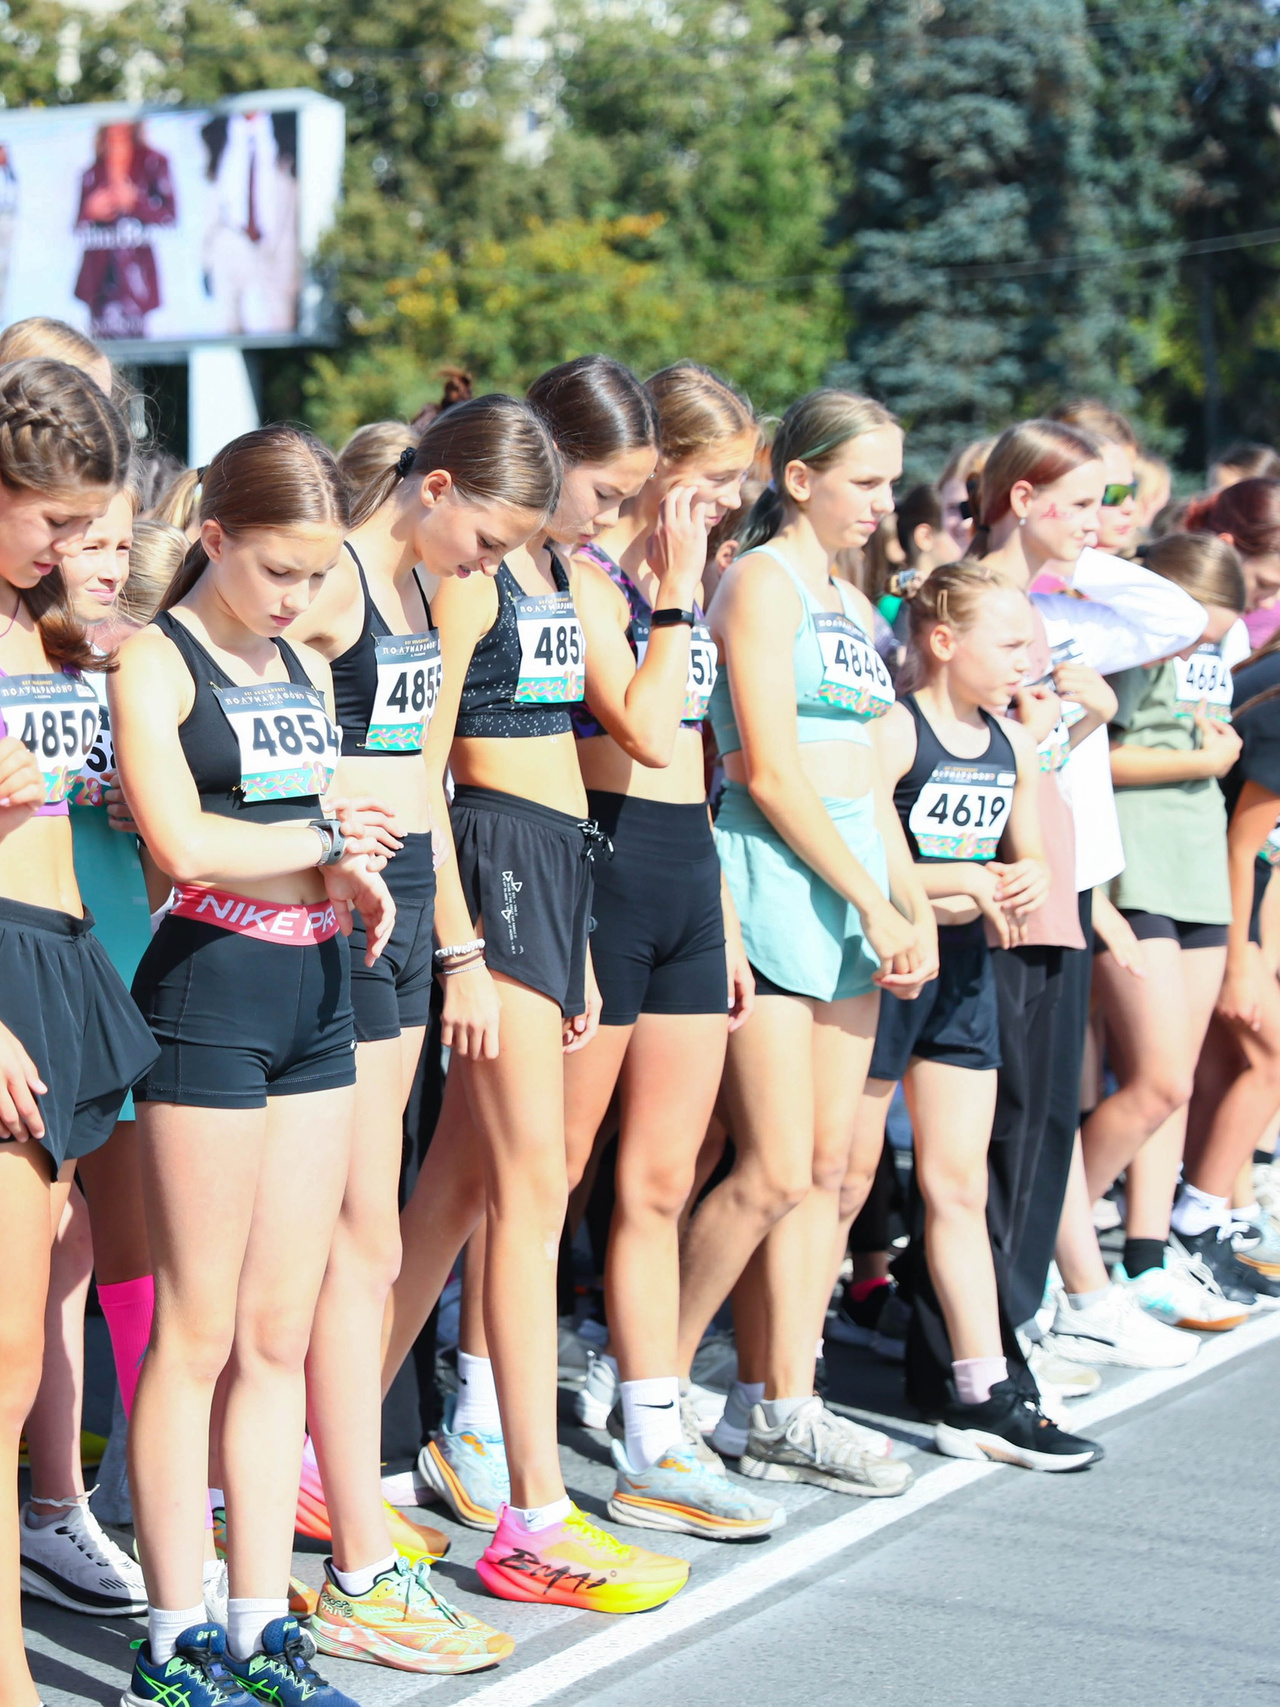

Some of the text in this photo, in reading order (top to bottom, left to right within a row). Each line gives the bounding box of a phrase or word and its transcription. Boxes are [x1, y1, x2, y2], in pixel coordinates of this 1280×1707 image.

[834, 639, 887, 687] 4846
[20, 708, 97, 758] 4850
[252, 714, 340, 757] 4854
[926, 793, 1006, 827] 4619
[196, 894, 301, 937] NIKE
[196, 1629, 219, 1642] ascs
